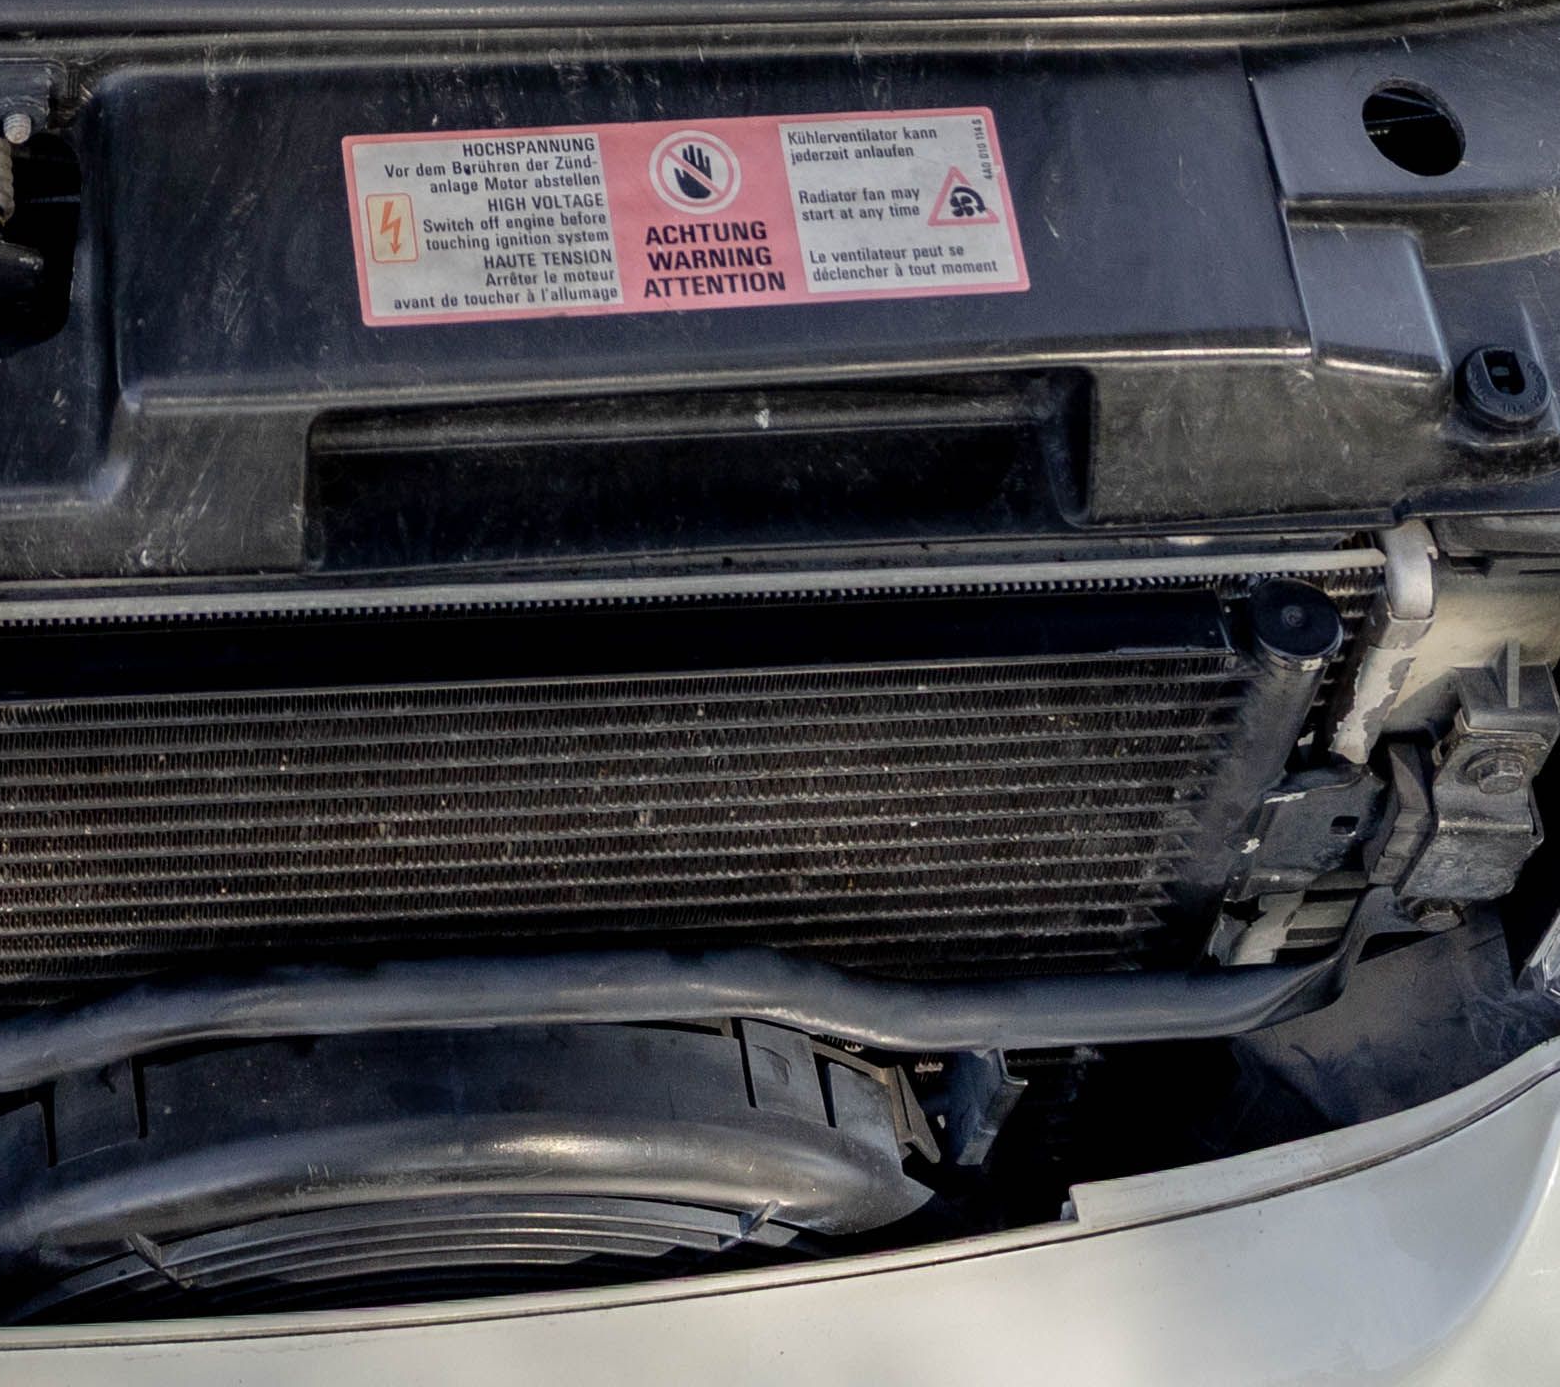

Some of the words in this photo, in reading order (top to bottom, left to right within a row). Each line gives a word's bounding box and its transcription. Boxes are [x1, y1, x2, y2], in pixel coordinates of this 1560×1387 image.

[787, 128, 898, 146] Kühlerventilator
[903, 126, 938, 140] kann
[463, 137, 595, 158] HOCHSPANNUNG
[791, 146, 849, 165] jederzeit
[854, 144, 915, 159] anlaufen
[384, 164, 410, 178] Vor
[416, 161, 446, 177] dem
[452, 158, 520, 176] Berühren
[526, 157, 549, 172] der
[554, 154, 598, 171] Zünd-
[430, 177, 479, 195] anlage
[484, 175, 528, 192] Motor
[534, 173, 601, 189] abstellen
[487, 197, 527, 213] HIGH
[532, 193, 605, 211] VOLTAGE
[798, 189, 857, 205] Radiator
[863, 187, 886, 202] fan
[891, 187, 921, 202] may
[802, 207, 834, 222] start
[840, 206, 854, 220] at
[859, 206, 884, 221] any
[889, 202, 921, 217] time
[422, 216, 475, 234] Switch
[480, 215, 499, 230] off
[506, 213, 555, 231] engine
[561, 212, 607, 227] before
[645, 220, 768, 246] ACHTUNG
[426, 234, 490, 251] touching
[496, 232, 551, 249] ignition
[557, 230, 609, 247] system
[483, 253, 536, 270] HAUTE
[543, 249, 612, 266] TENSION
[646, 246, 773, 272] WARNING
[809, 250, 827, 265] Le
[831, 246, 907, 263] ventilateur
[912, 245, 944, 261] peut
[948, 245, 965, 257] se
[485, 271, 537, 287] Arrêter
[545, 269, 558, 283] le
[564, 268, 615, 283] moteur
[813, 265, 889, 282] déclencher
[894, 263, 904, 278] à
[908, 262, 937, 276] tout
[942, 260, 998, 275] moment
[644, 271, 786, 298] ATTENTION
[394, 296, 435, 310] avant
[441, 293, 458, 307] de
[464, 289, 520, 307] toucher
[527, 287, 536, 303] à
[541, 285, 618, 303] l'allumage
